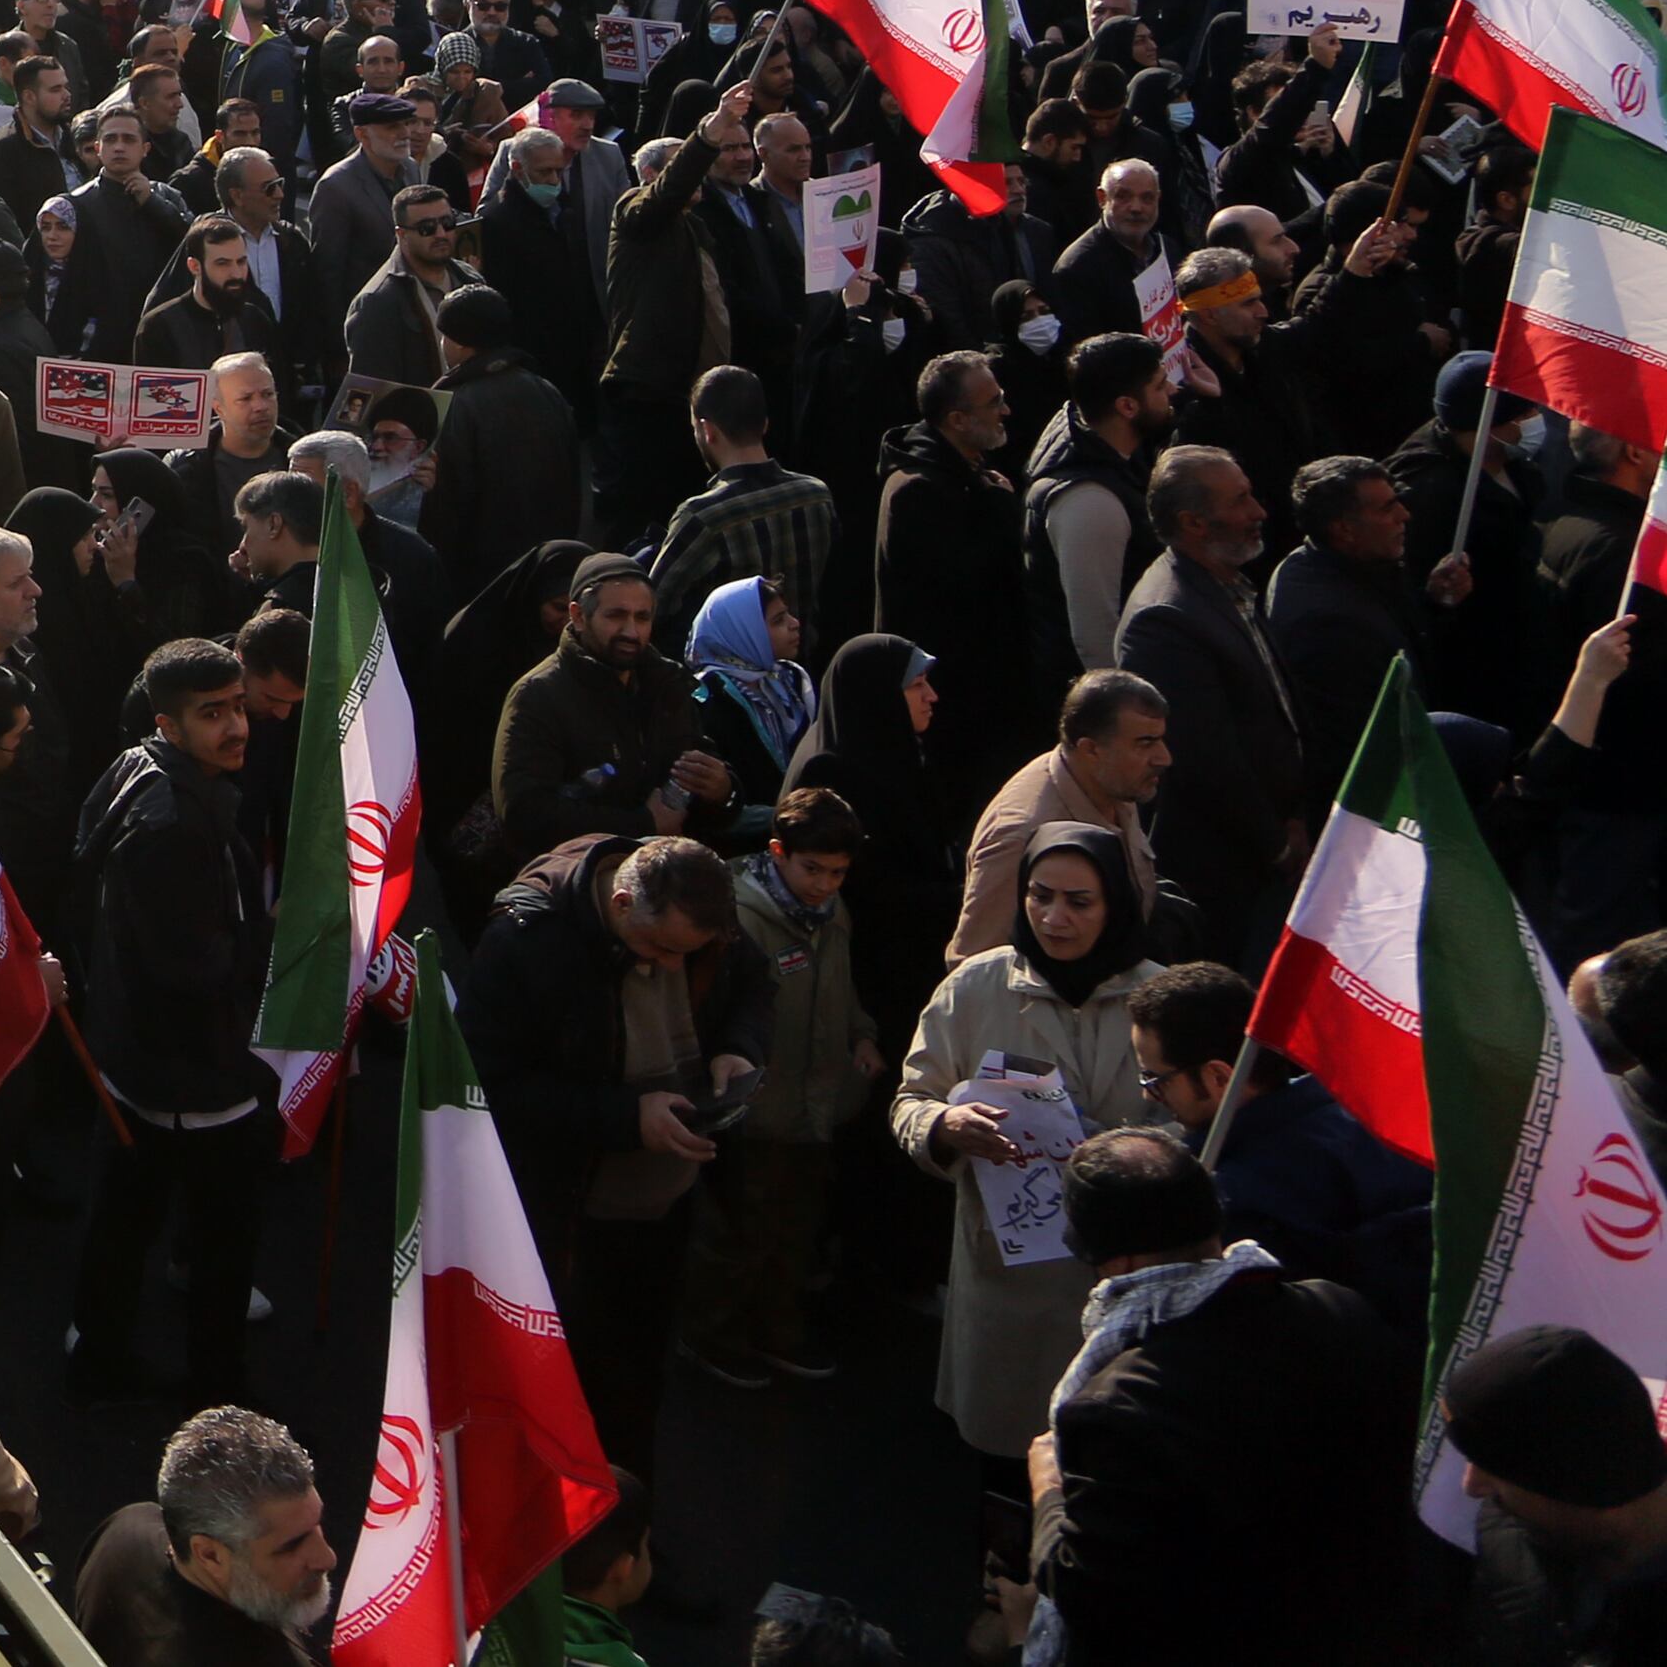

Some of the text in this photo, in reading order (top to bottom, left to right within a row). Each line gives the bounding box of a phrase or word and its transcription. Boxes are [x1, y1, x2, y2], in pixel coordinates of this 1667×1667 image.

[134, 422, 197, 434] مرگ بر اسرائیل
